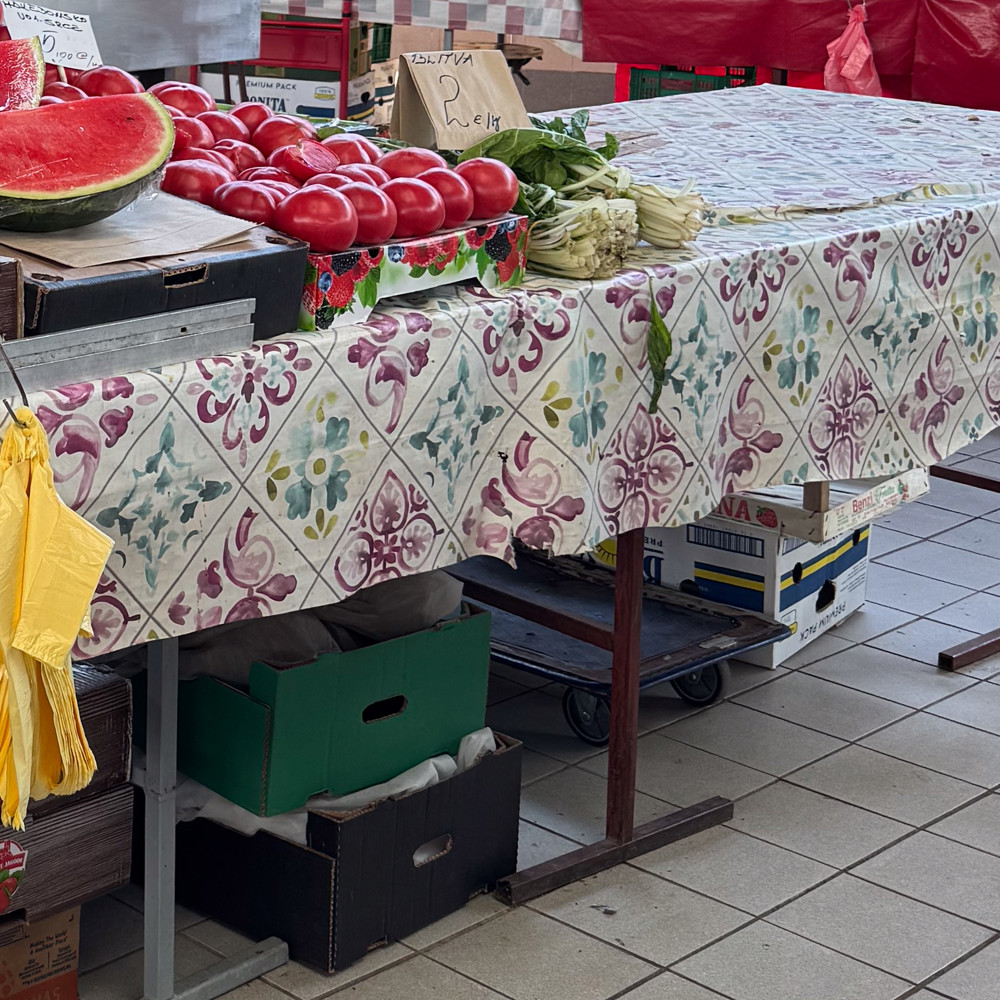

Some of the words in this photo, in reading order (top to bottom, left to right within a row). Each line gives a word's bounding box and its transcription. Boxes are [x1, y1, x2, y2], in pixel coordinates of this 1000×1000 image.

[235, 80, 274, 88] PEMIUM
[276, 82, 298, 91] PACK
[851, 492, 875, 514] Benzi
